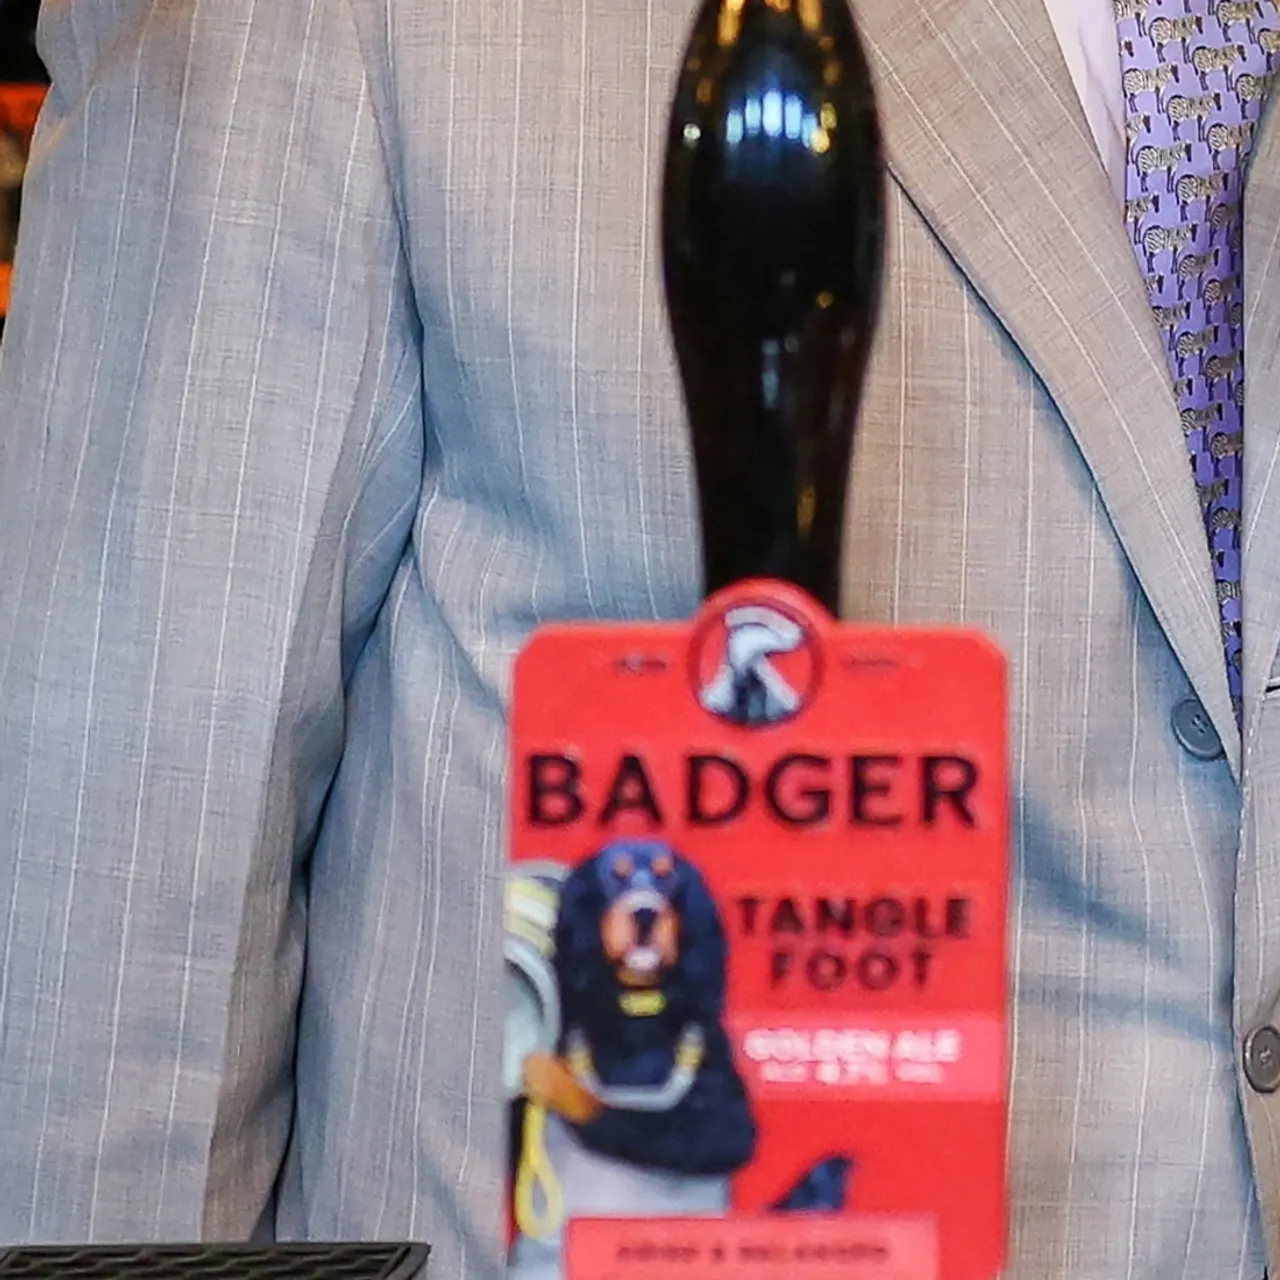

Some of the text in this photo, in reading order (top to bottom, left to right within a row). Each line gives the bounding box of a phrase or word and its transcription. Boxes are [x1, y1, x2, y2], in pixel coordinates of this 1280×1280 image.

[526, 753, 980, 829] BADGER
[734, 896, 970, 940] TANGLE
[770, 950, 933, 991] FOOT
